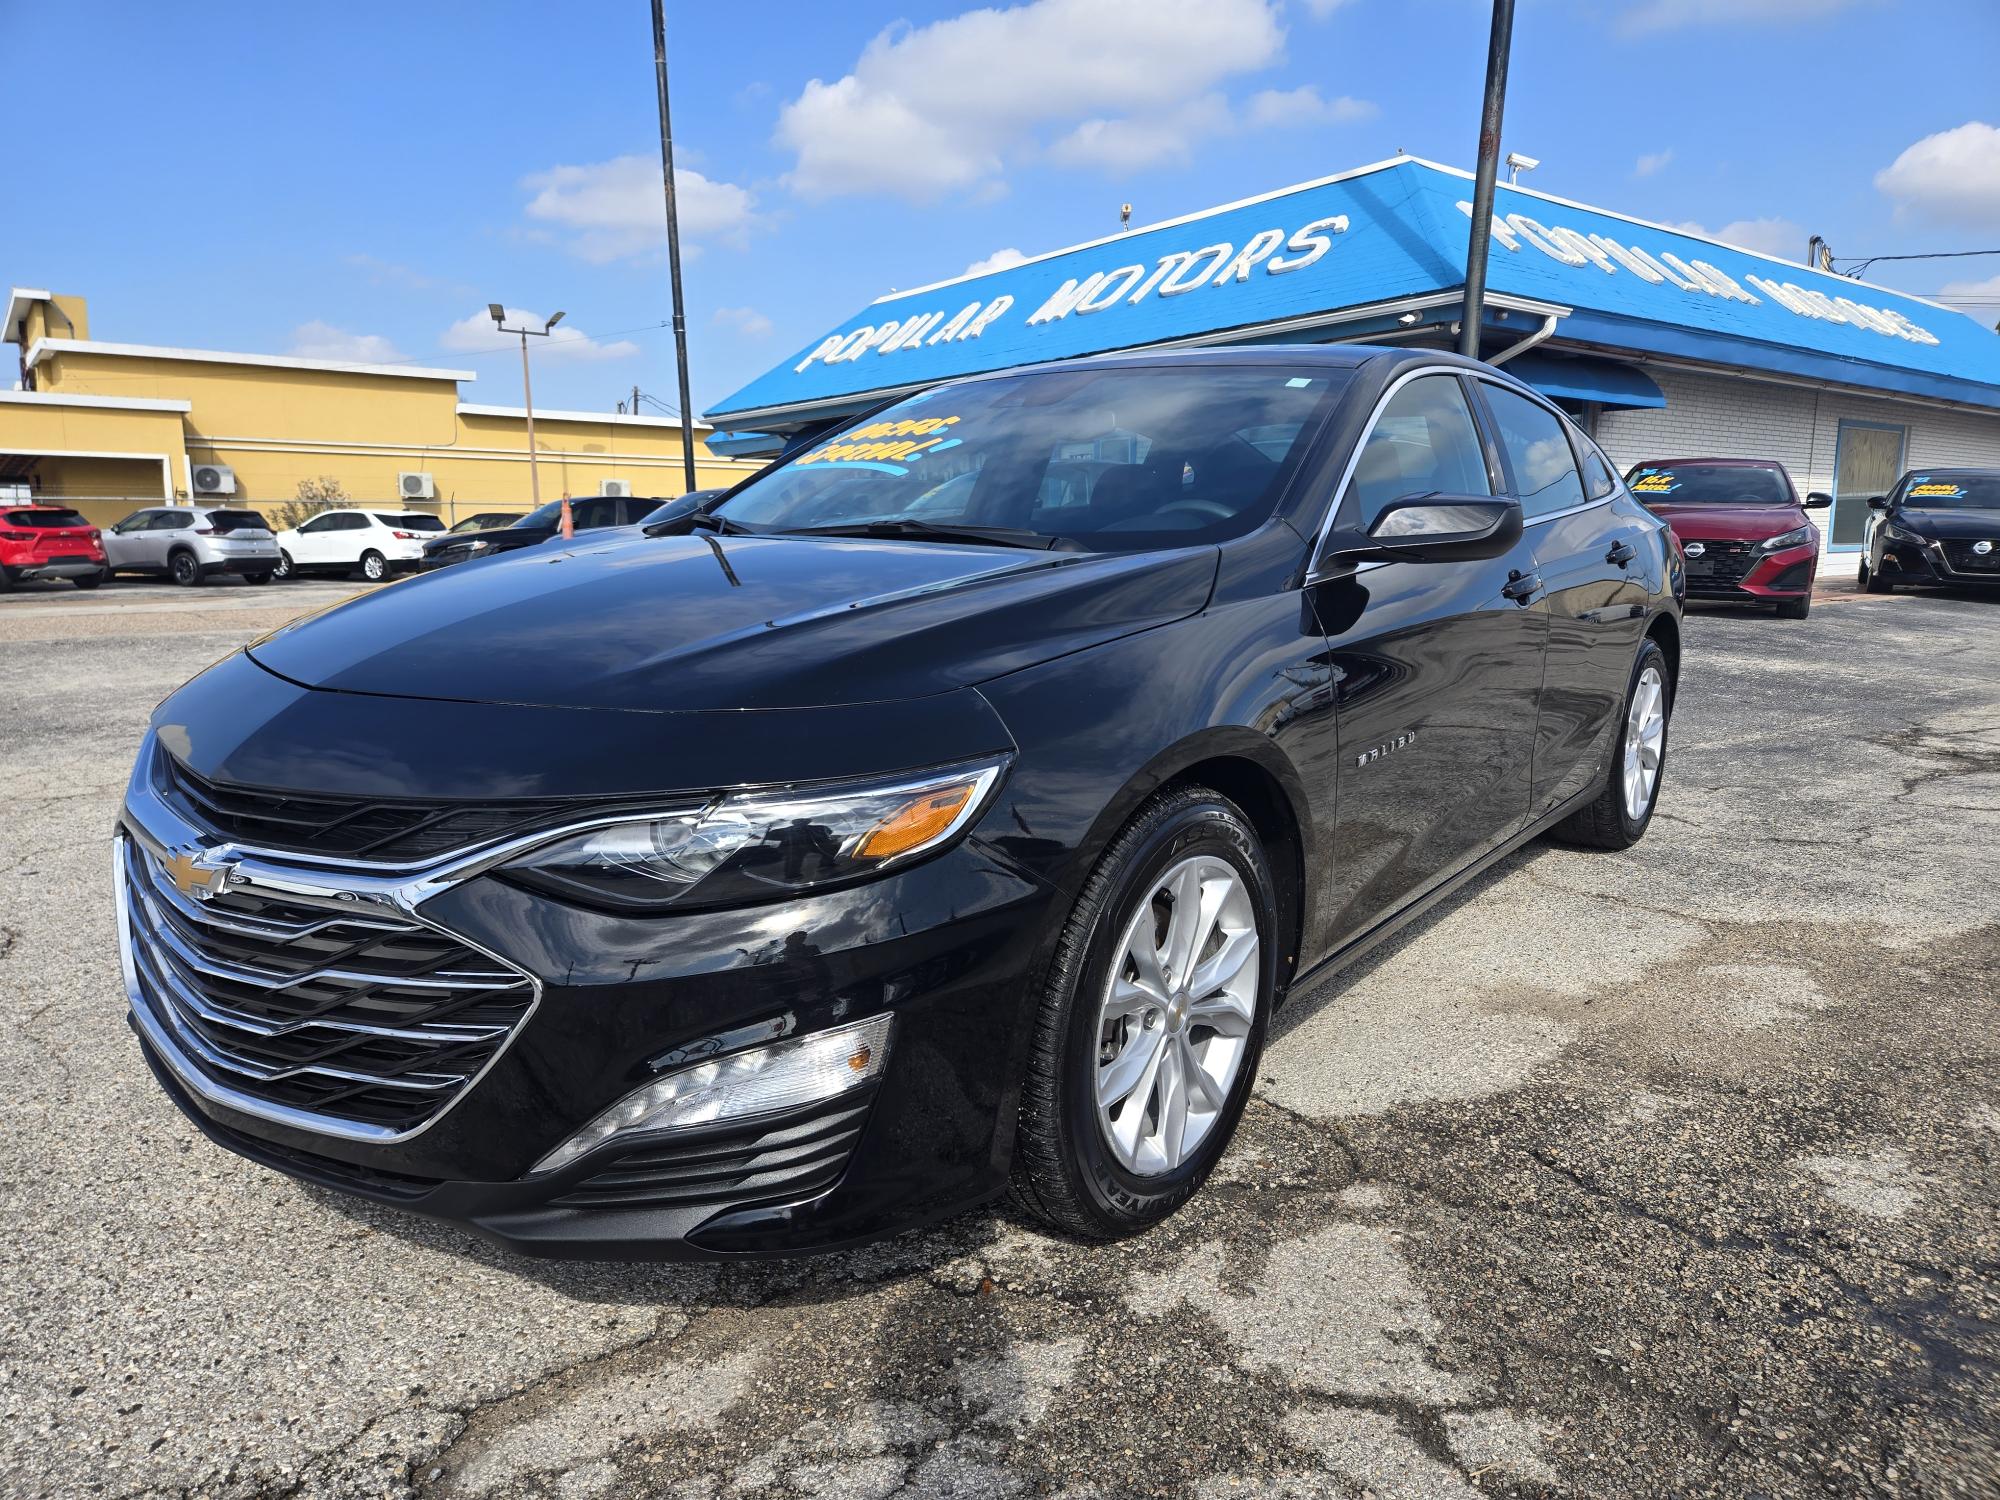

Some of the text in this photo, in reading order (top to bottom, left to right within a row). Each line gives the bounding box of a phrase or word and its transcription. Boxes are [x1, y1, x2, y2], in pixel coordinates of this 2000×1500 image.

[793, 214, 1350, 374] POPULAR MOTORS
[1355, 732, 1415, 768] MALIBU
